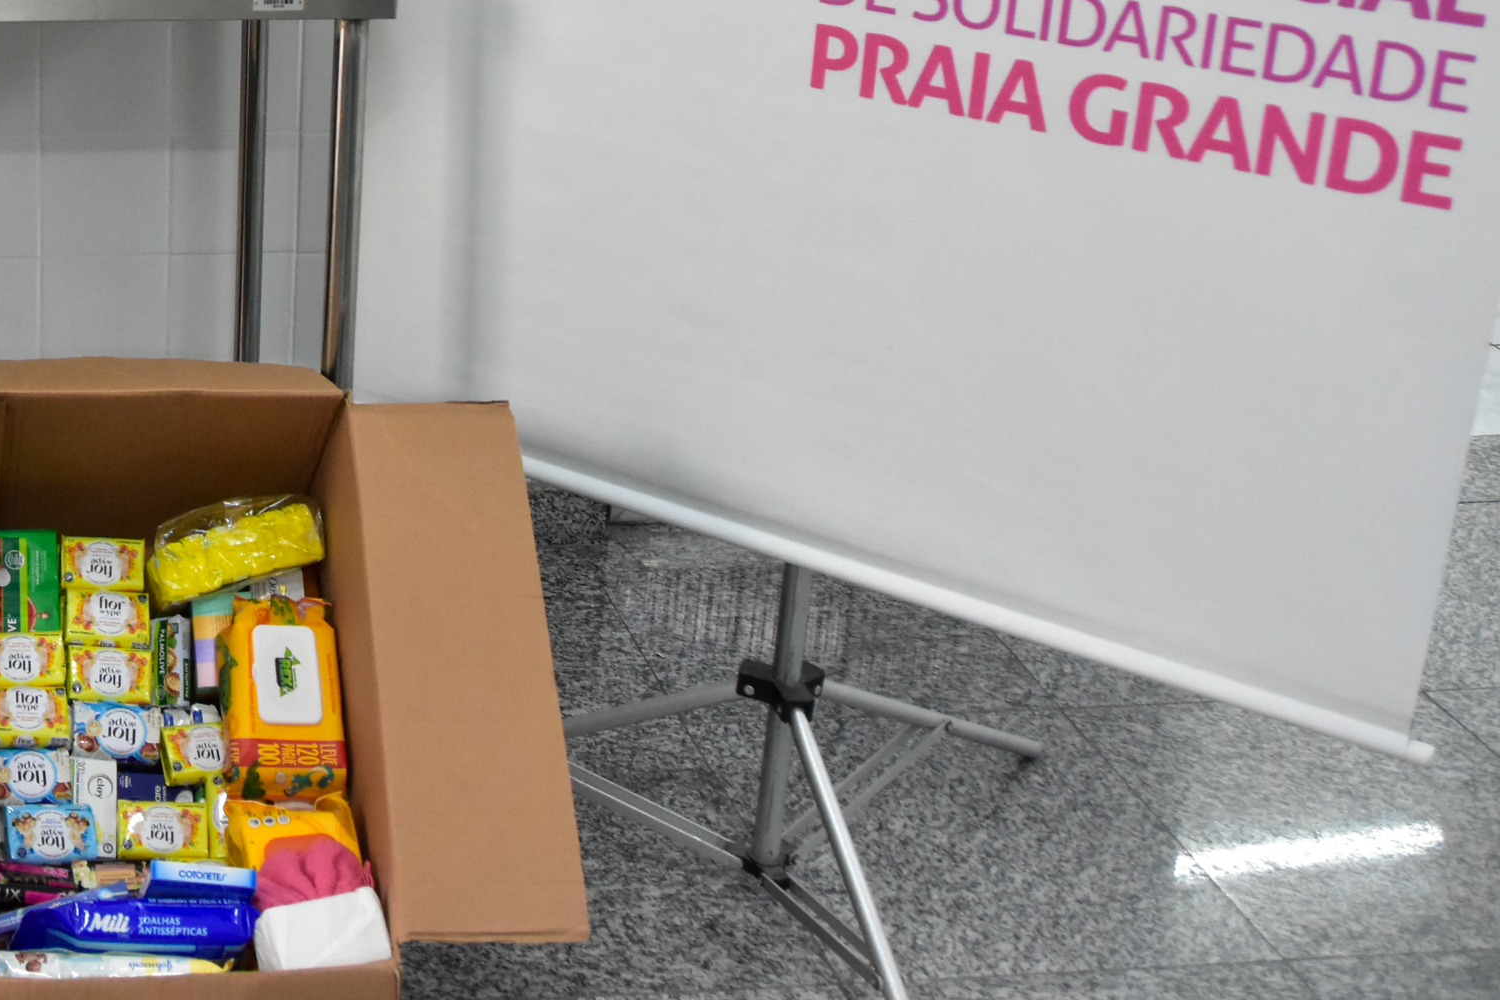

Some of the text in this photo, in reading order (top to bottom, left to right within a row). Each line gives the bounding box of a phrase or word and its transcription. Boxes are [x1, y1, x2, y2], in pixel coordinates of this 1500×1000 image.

[810, 23, 1463, 211] PRAIA GRANDE
[86, 563, 112, 577] flor
[99, 596, 125, 609] flor
[5, 659, 32, 674] flor
[95, 674, 122, 688] flor
[15, 690, 42, 704] flor
[258, 744, 281, 766] 100
[296, 744, 320, 766] 120
[320, 744, 337, 766] LEVE
[95, 778, 105, 800] cloy
[178, 869, 227, 881] COTONETES
[89, 913, 130, 934] Mili
[138, 926, 208, 937] ANTISSÉPTICAS
